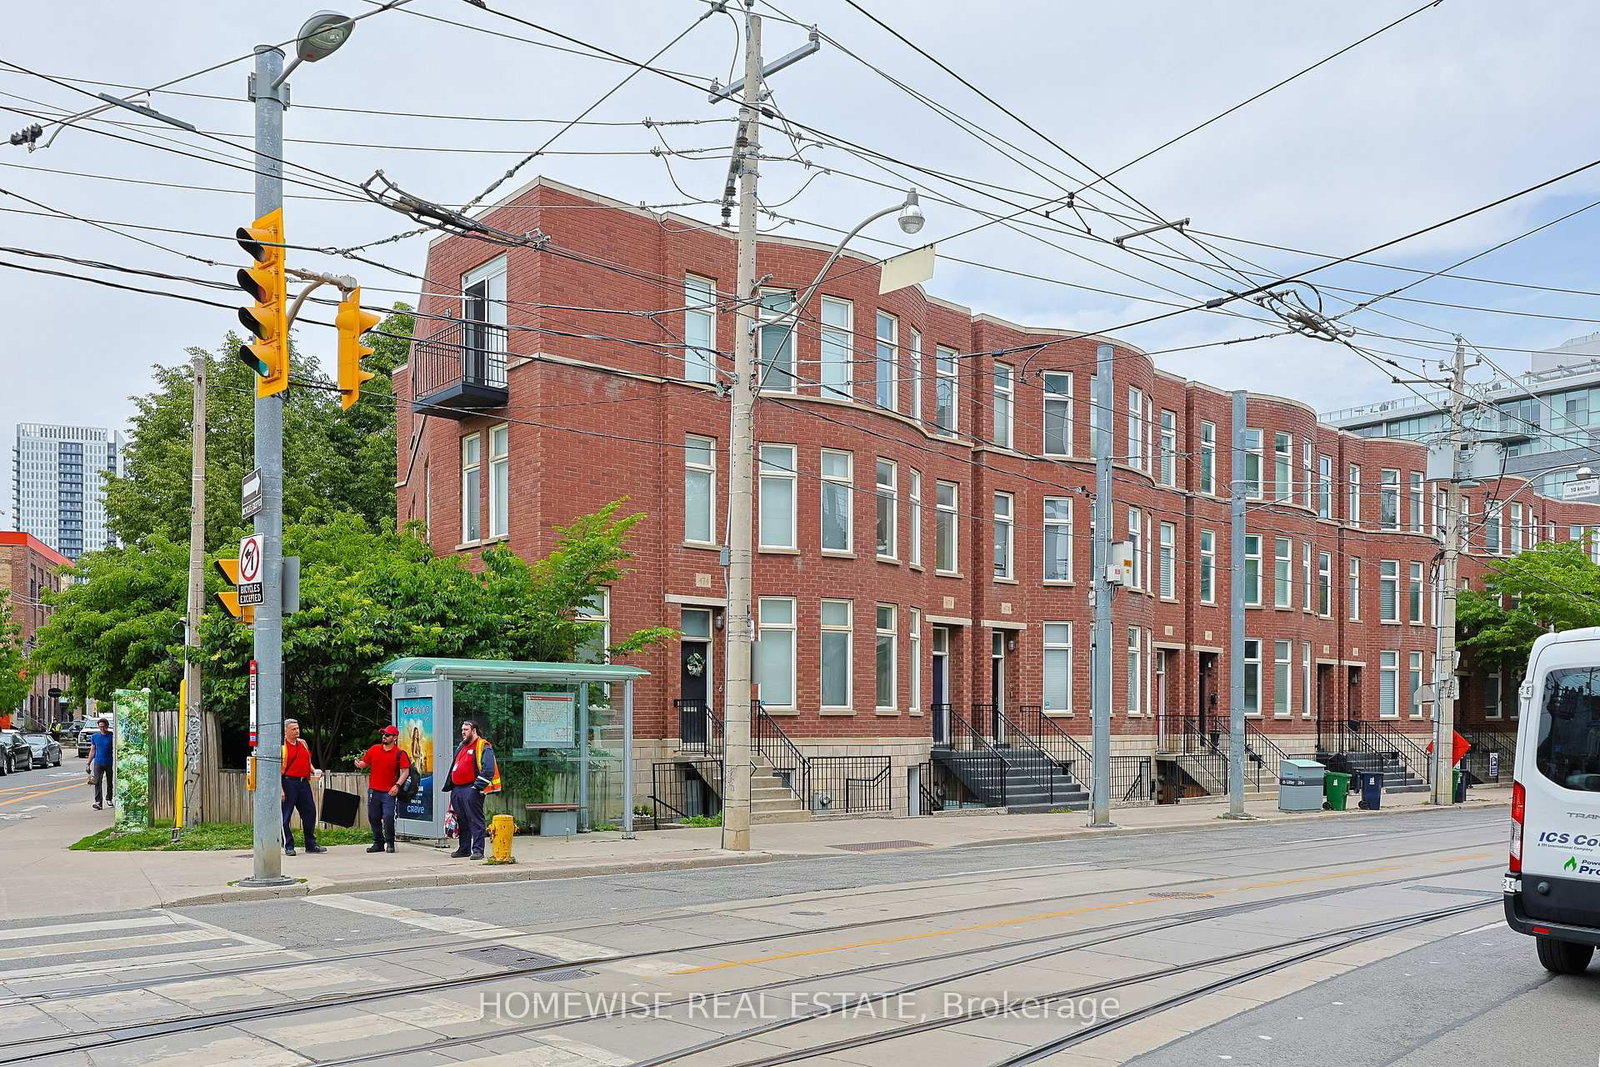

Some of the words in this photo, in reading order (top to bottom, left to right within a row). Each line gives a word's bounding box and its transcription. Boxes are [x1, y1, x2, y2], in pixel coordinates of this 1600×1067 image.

[240, 584, 261, 595] BICYCLES
[1539, 832, 1570, 844] ICS
[1573, 834, 1600, 847] Co
